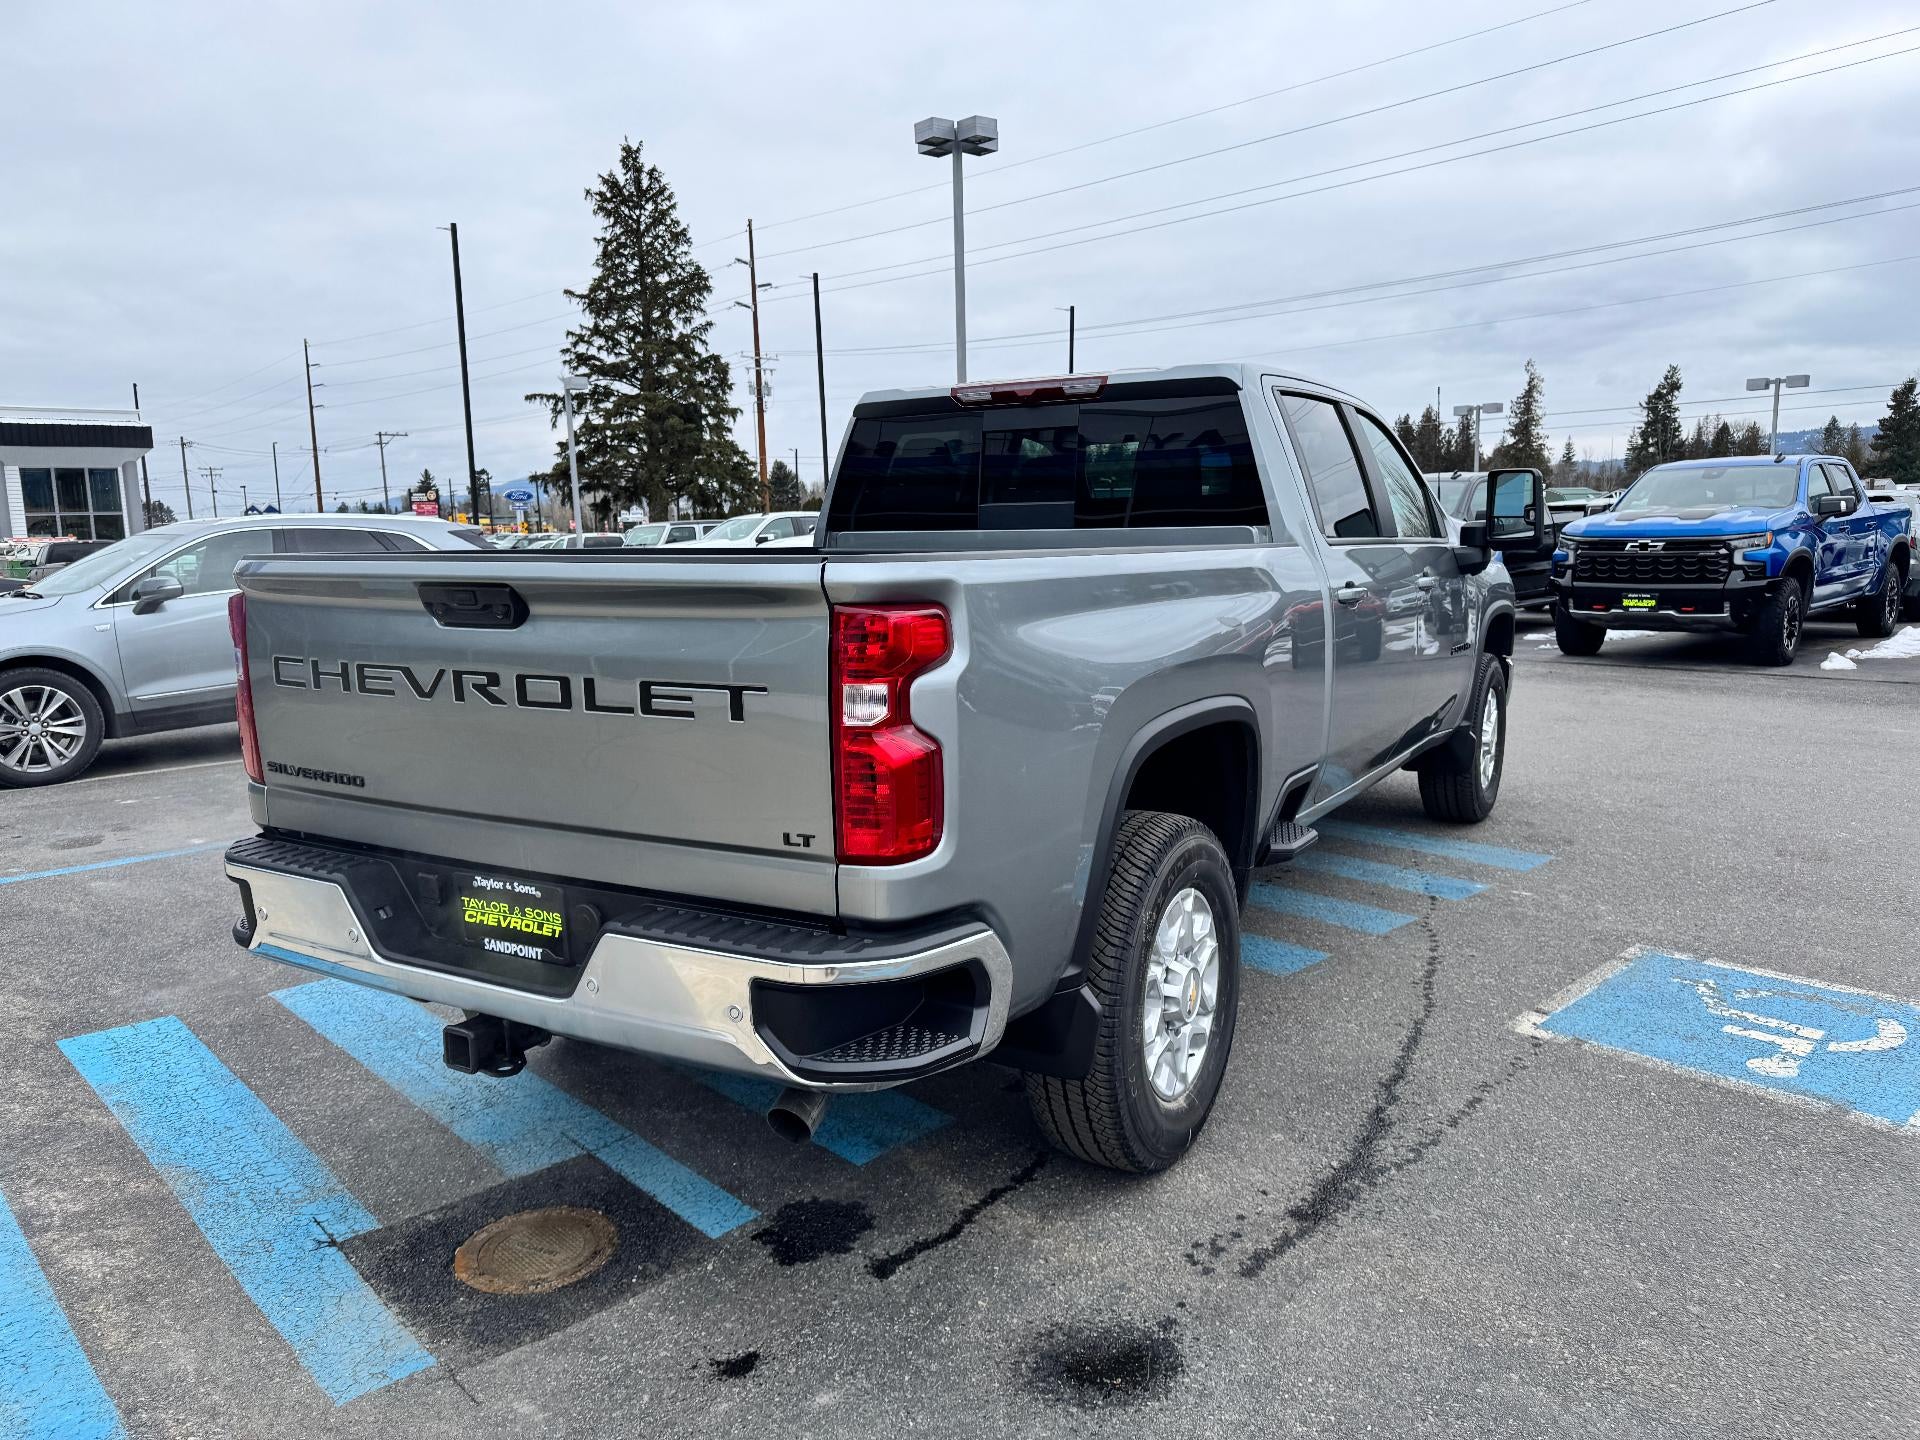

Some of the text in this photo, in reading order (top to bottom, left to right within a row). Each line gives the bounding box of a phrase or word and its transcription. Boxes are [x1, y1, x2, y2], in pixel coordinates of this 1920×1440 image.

[273, 655, 768, 723] CHEVROLET
[266, 761, 365, 788] SILVERADO
[782, 831, 816, 848] LT
[474, 876, 536, 896] Taylor & Sons
[461, 896, 562, 924] TAYLOR & SONS
[464, 910, 563, 938] CHEVROLET
[484, 937, 543, 960] SANDPOINT
